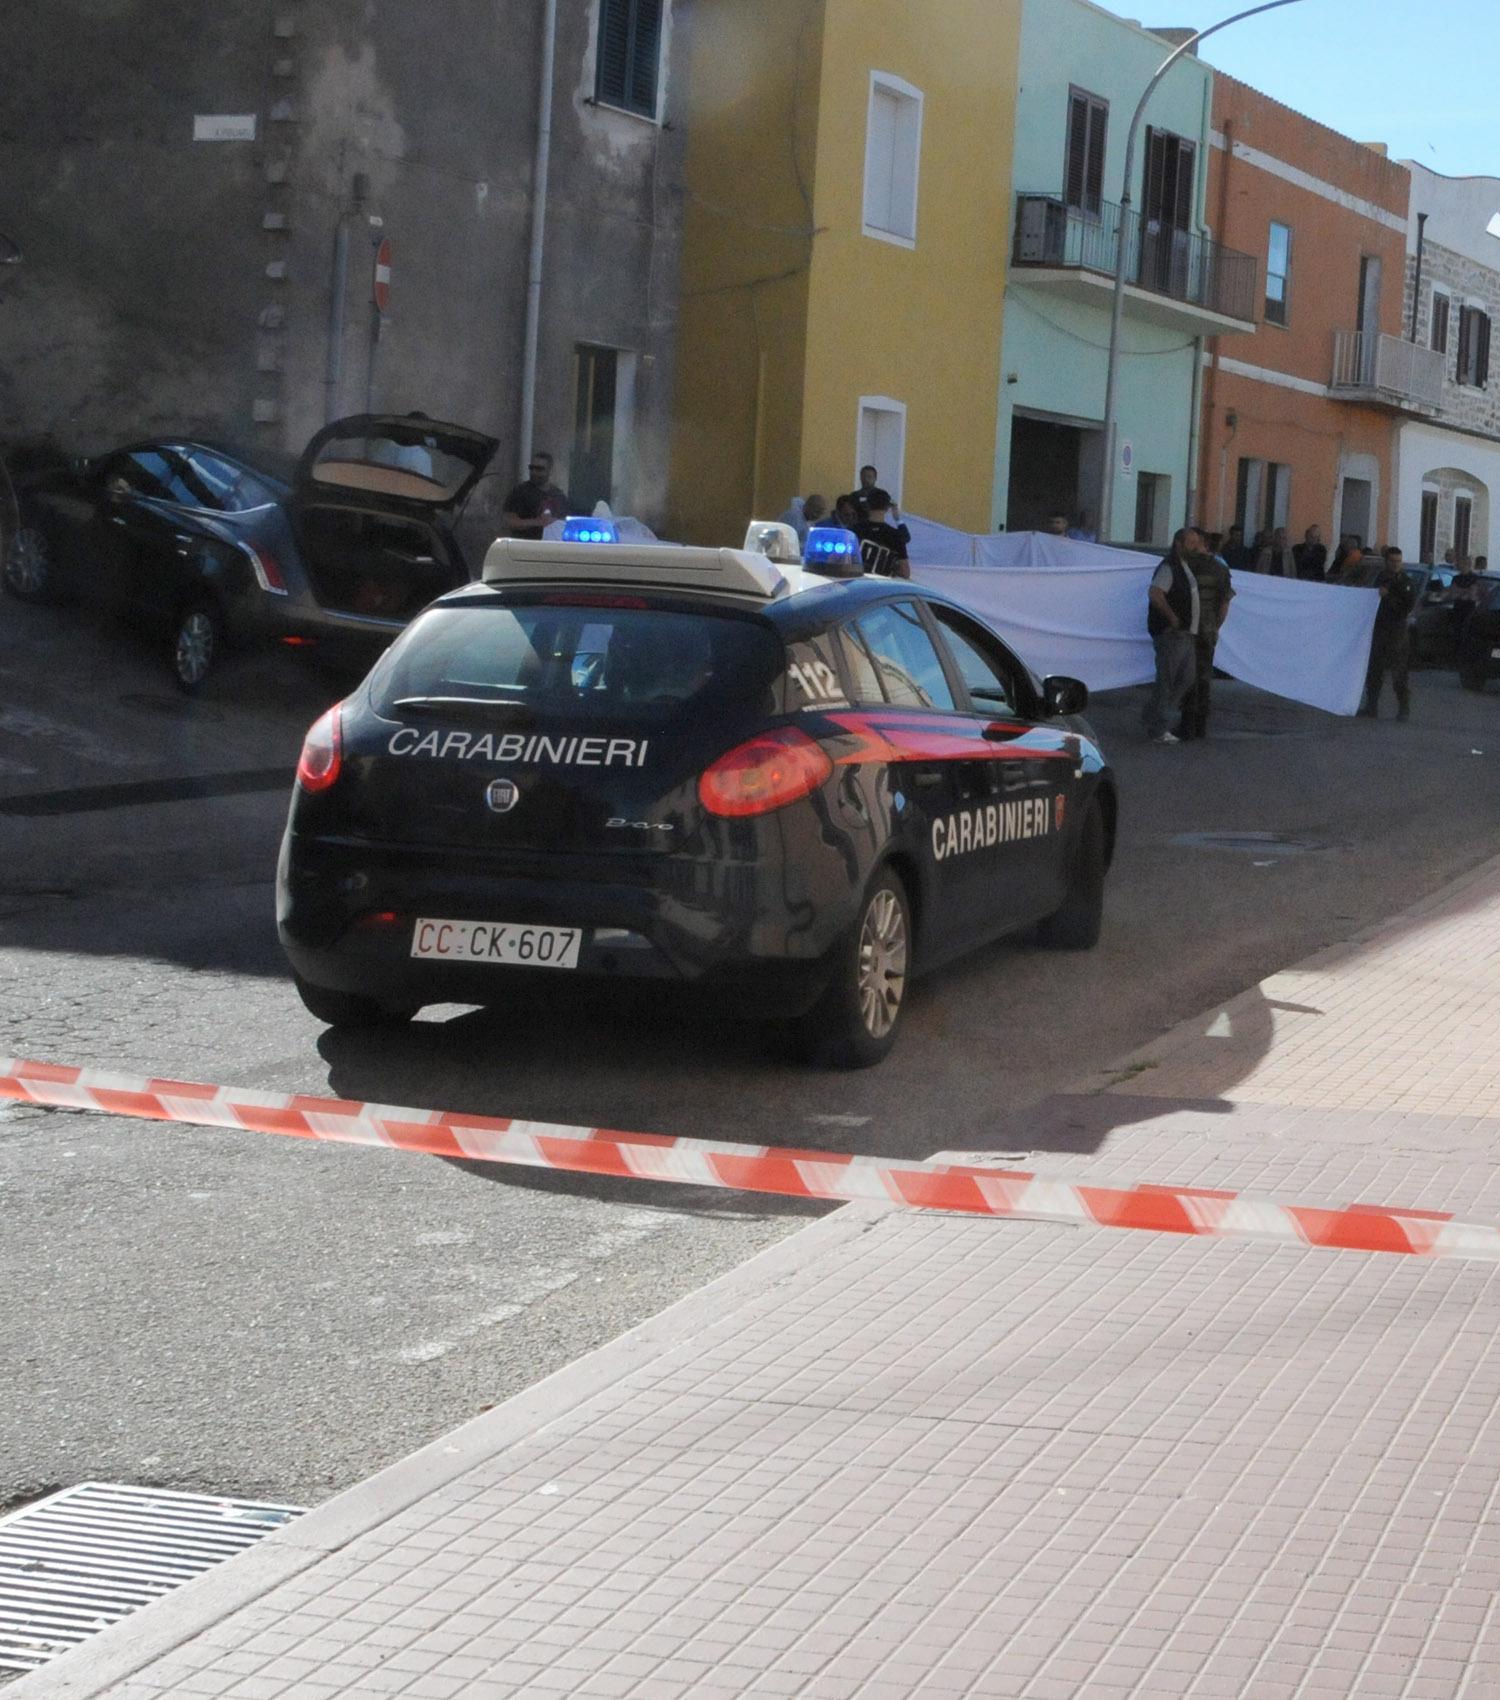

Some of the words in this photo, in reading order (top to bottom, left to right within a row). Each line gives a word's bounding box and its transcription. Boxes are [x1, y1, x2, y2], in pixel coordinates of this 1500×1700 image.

[788, 660, 845, 699] 112
[388, 728, 648, 767] CARABINIERI
[931, 797, 1050, 861] CARABINIERI
